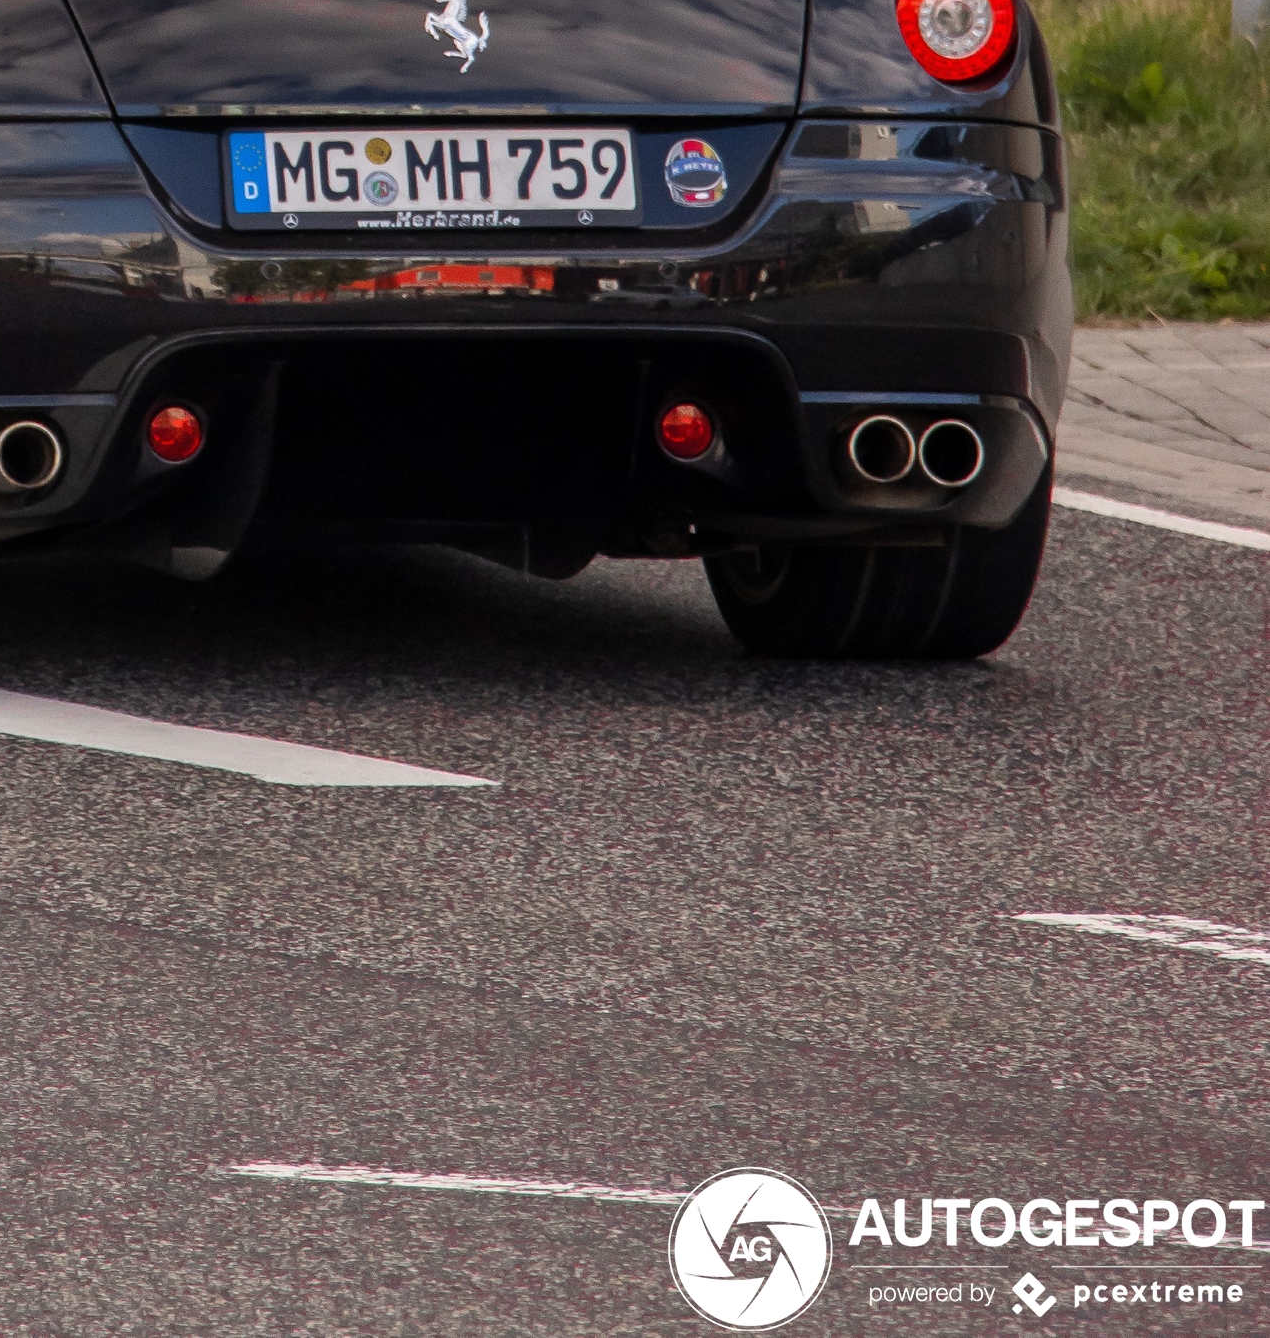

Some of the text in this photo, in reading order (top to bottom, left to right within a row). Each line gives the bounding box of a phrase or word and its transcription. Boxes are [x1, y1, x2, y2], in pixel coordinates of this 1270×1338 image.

[243, 181, 259, 200] D
[273, 139, 627, 203] MG MH 759
